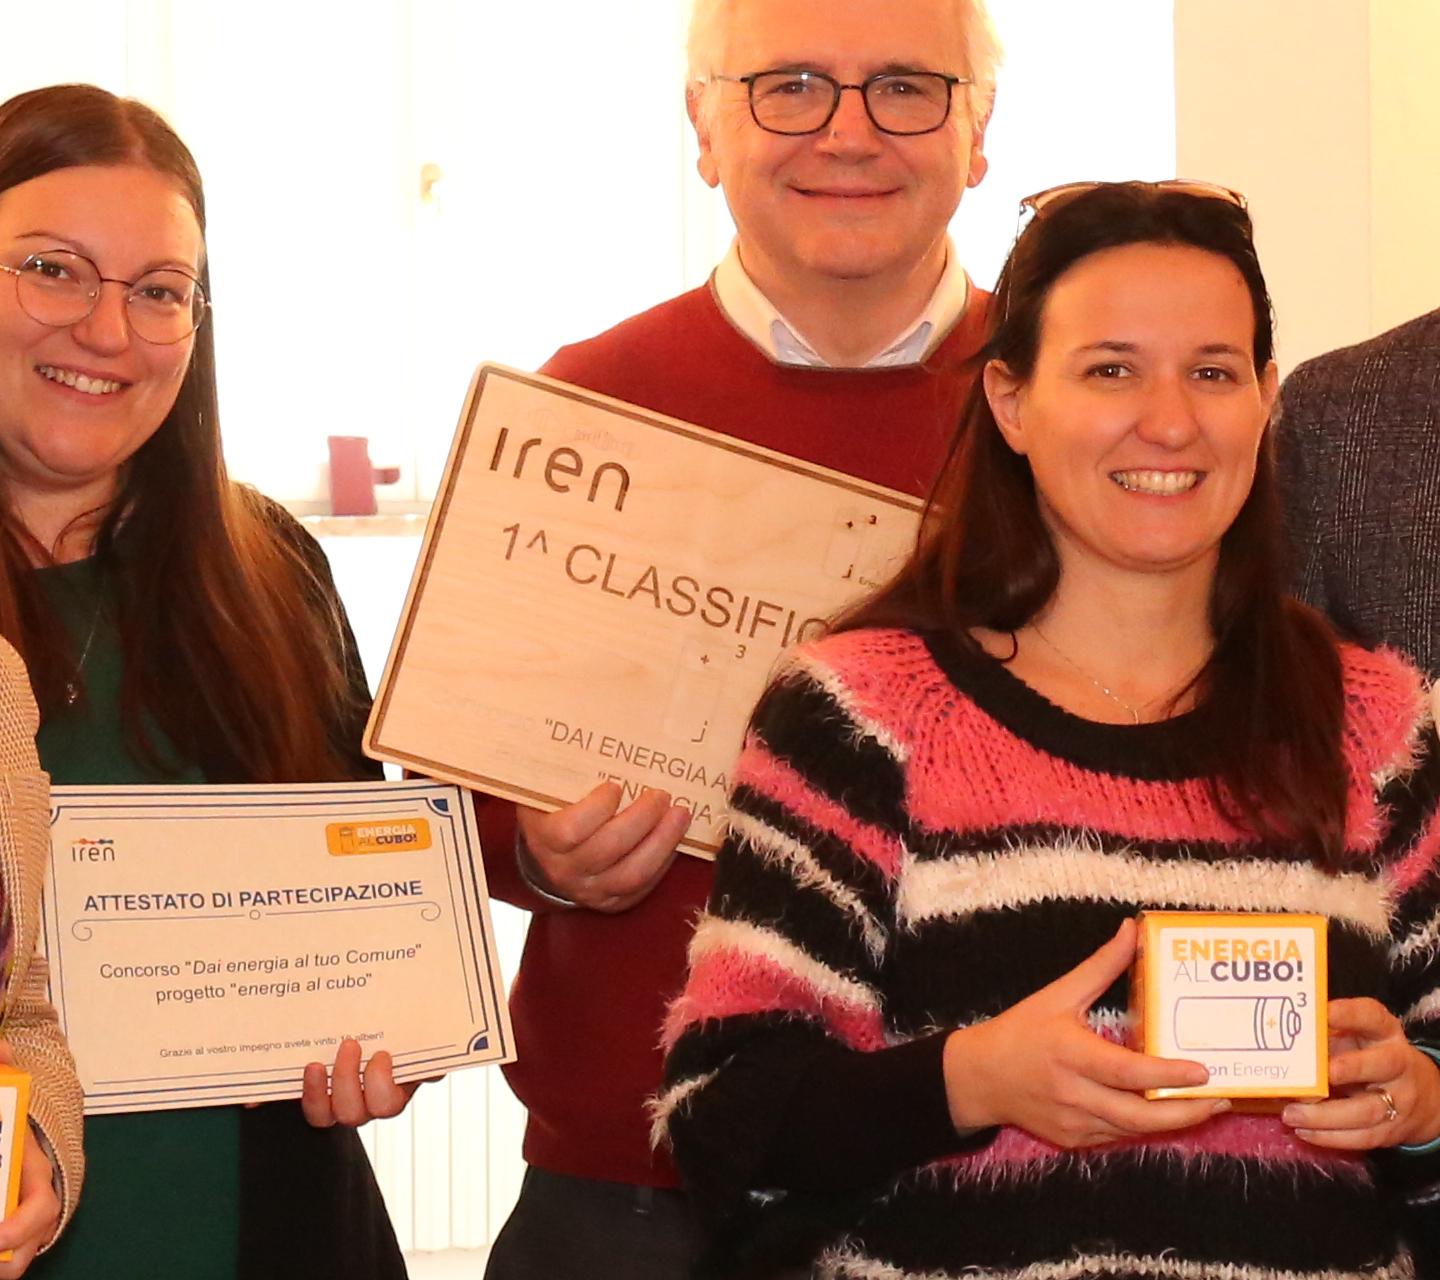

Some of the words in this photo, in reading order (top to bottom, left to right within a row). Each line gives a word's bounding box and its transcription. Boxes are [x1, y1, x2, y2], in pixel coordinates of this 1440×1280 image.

[545, 717, 594, 751] "DAI
[599, 735, 707, 786] ENERGIA
[711, 772, 734, 792] A
[356, 823, 417, 838] ENERGIA
[375, 833, 417, 845] CUBO!
[83, 892, 206, 912] ATTESTATO
[212, 892, 233, 909] DI
[239, 879, 424, 907] PARTECIPAZIONE
[1171, 938, 1303, 961] ENERGIA
[99, 962, 181, 979] Concorso
[184, 959, 222, 975] "Dai
[226, 955, 289, 974] energia
[294, 954, 309, 969] al
[314, 953, 341, 968] tuo
[345, 943, 422, 965] Comune"
[1210, 960, 1304, 982] CUBO!
[155, 985, 226, 1006] progetto
[230, 979, 301, 998] "energia
[306, 977, 321, 992] al
[326, 973, 373, 990] cubo"
[1296, 992, 1308, 1008] 3
[159, 1047, 193, 1058] Grazie
[195, 1046, 205, 1056] al
[207, 1044, 237, 1055] vostro
[239, 1042, 282, 1054] impegno
[284, 1039, 312, 1050] avete
[313, 1036, 337, 1048] vinto
[1233, 1061, 1289, 1079] Energy
